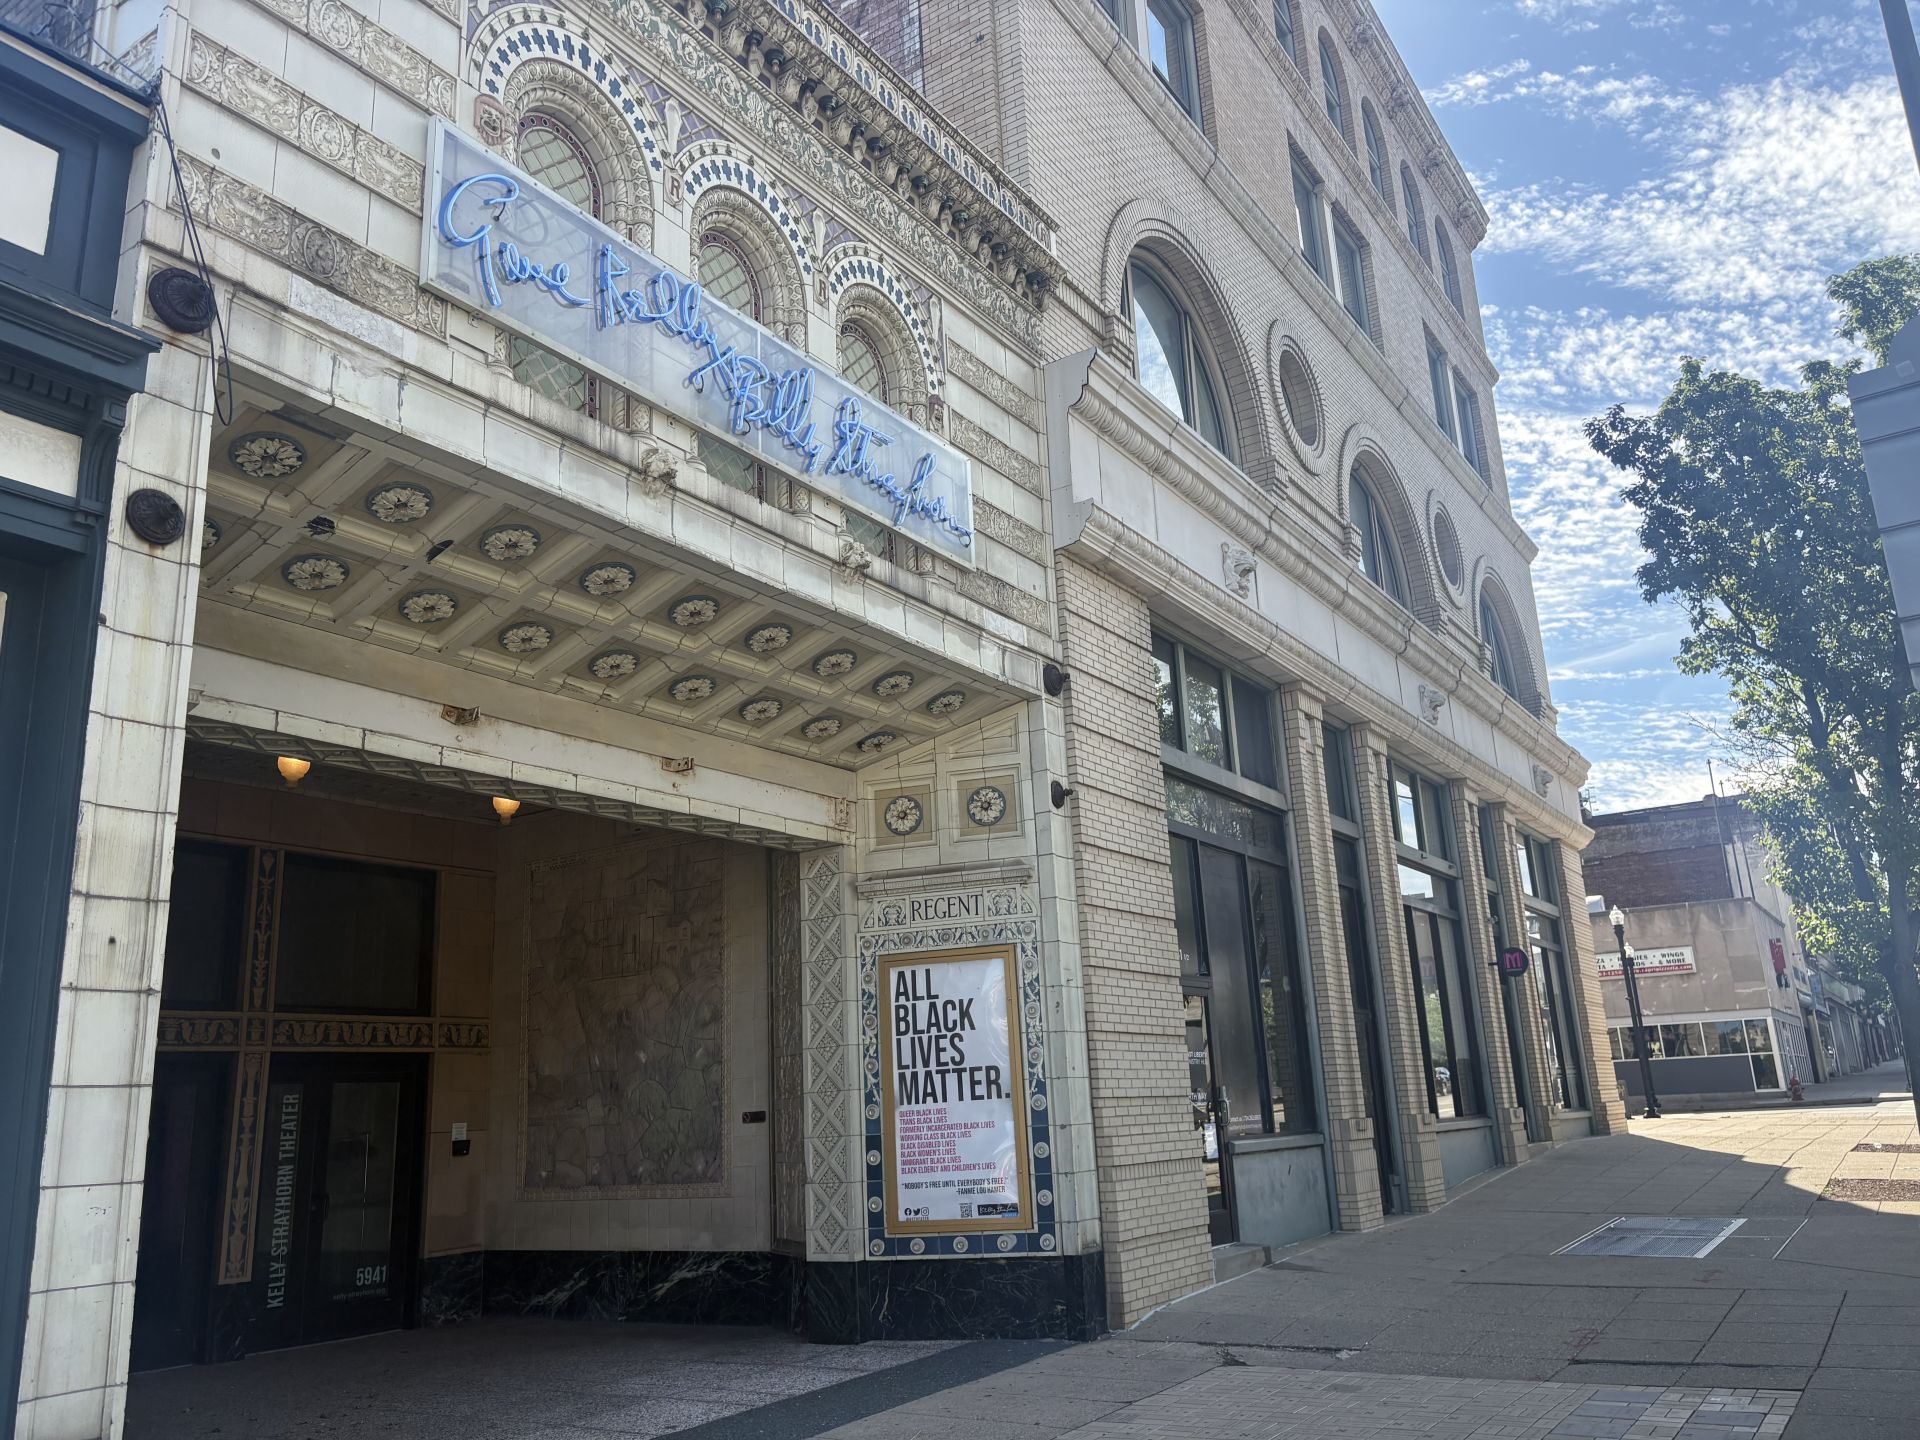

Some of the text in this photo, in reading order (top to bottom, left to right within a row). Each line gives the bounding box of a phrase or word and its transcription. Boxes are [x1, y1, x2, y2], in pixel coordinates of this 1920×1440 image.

[439, 174, 591, 306] Gene
[911, 894, 983, 921] REGENT
[895, 968, 939, 1003] ALL
[895, 998, 976, 1036] BLACK
[896, 1032, 965, 1070] LIVES
[898, 1065, 1011, 1106] MATTER.
[899, 1107, 947, 1118] QUEER BLACK LIVES
[899, 1118, 915, 1126] TRANS
[899, 1120, 995, 1134] FORMERLY INCARCERATED BLACK LIVES
[900, 1130, 972, 1142] WORKING CLASS BLACK LIVES
[900, 1139, 956, 1150] BLACK DISABLED LIVES
[900, 1150, 917, 1158] BLACK
[941, 1148, 956, 1156] LIVES
[901, 1166, 918, 1174] BLACK
[918, 1165, 939, 1174] ELDERLY
[939, 1164, 951, 1172] AND
[981, 1162, 996, 1170] LIVES
[930, 1157, 947, 1165] BLACK
[942, 1180, 956, 1188] UNTIL
[266, 1093, 299, 1309] KELLY STRAYHORN THEATER
[356, 1265, 387, 1286] 5941
